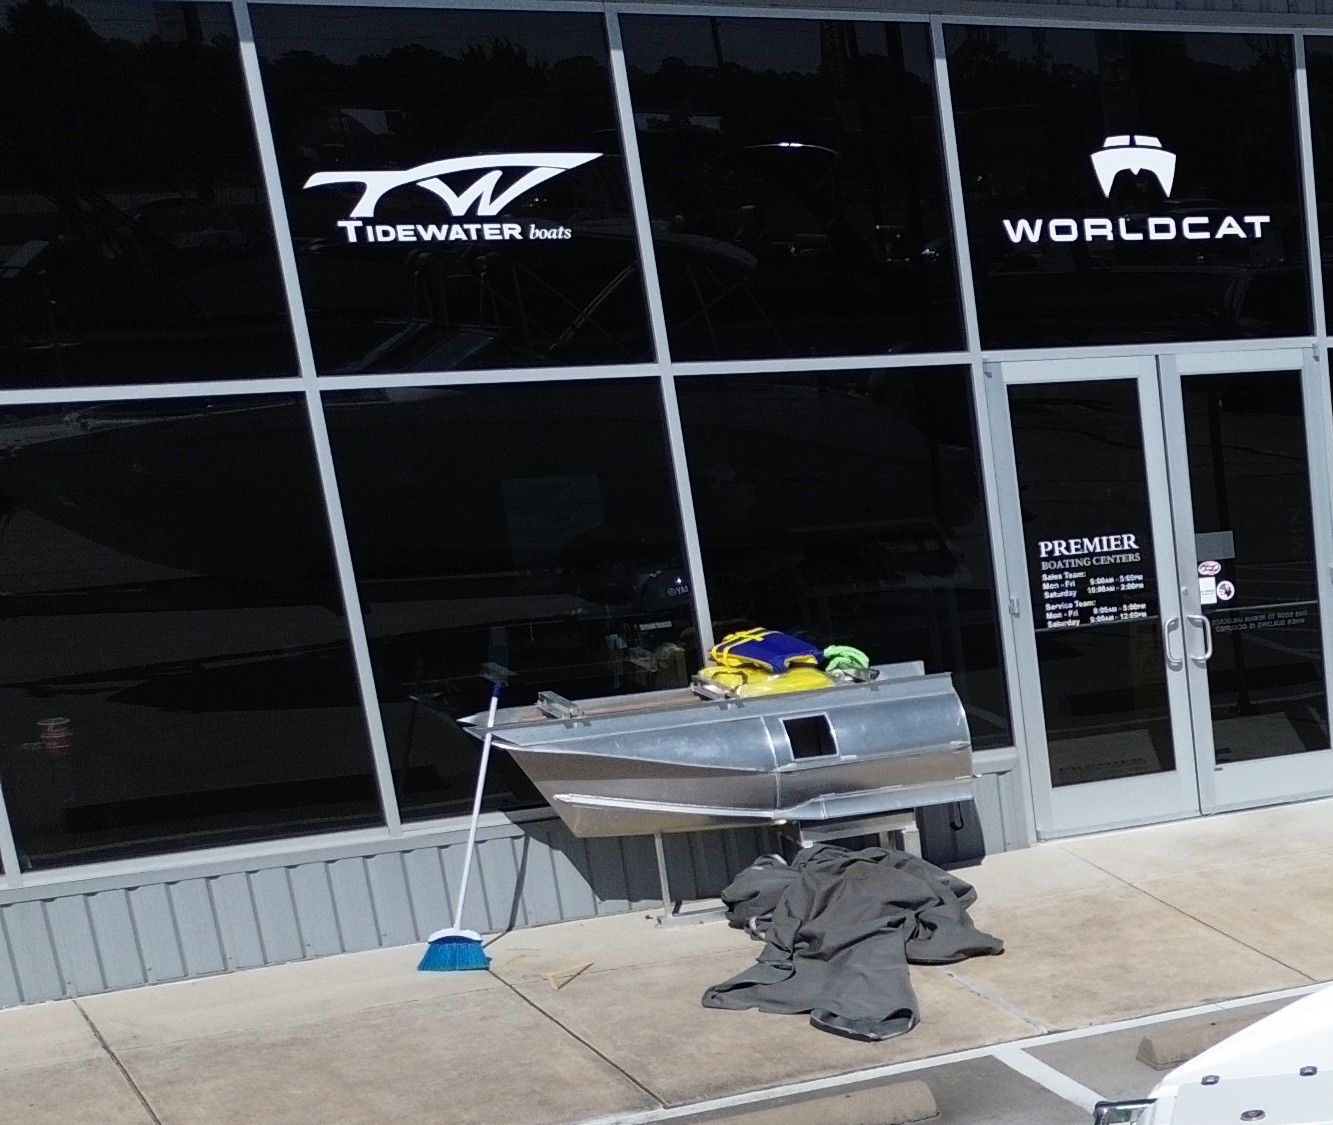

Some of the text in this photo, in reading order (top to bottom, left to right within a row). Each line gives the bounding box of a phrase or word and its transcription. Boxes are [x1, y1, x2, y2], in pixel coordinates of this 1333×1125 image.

[337, 220, 572, 243] TIDEWATER boats
[1002, 215, 1271, 243] WORLDCAT
[1038, 533, 1140, 558] PREMIER
[1041, 553, 1141, 571] BOATING CENTERS
[1043, 590, 1078, 600] Saturday
